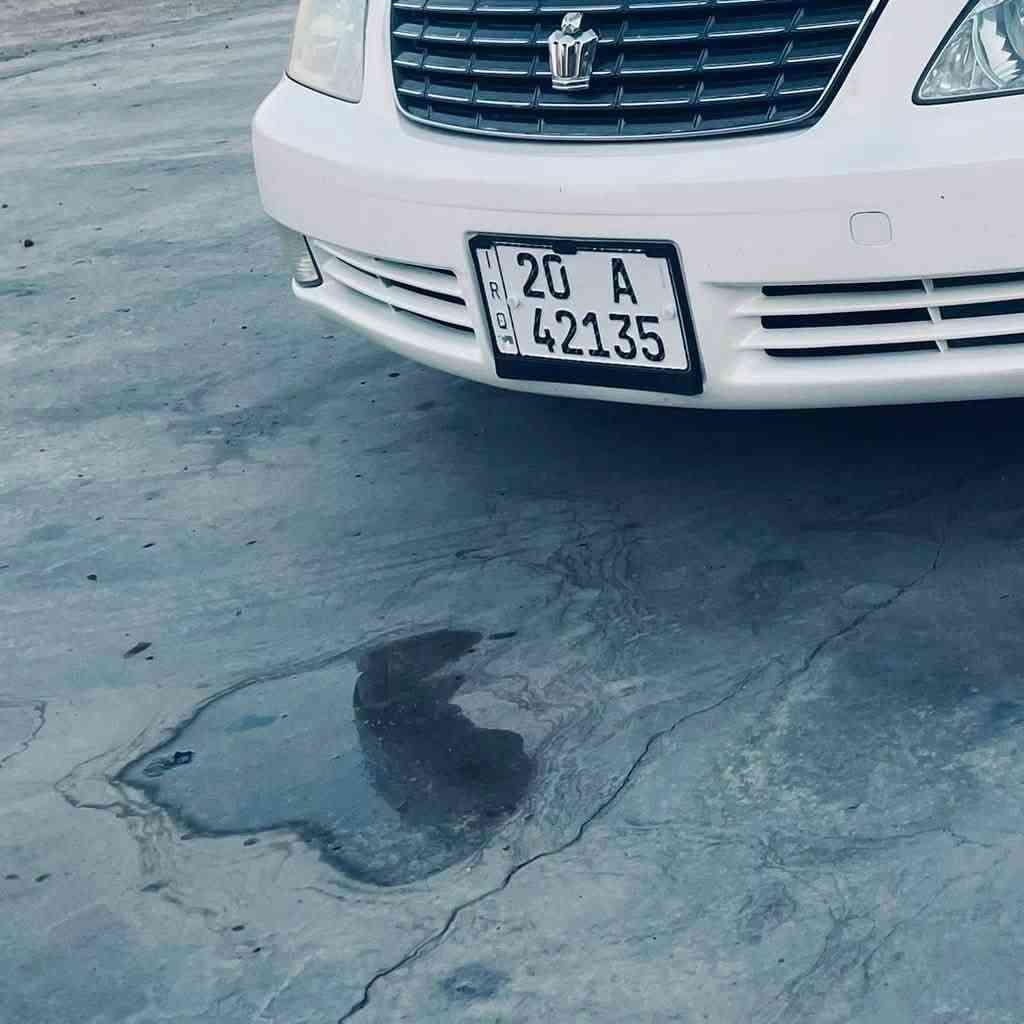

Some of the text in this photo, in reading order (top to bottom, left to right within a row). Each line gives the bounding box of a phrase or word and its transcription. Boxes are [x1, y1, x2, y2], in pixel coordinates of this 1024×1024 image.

[516, 252, 638, 305] 20 A
[532, 307, 666, 362] 42135
